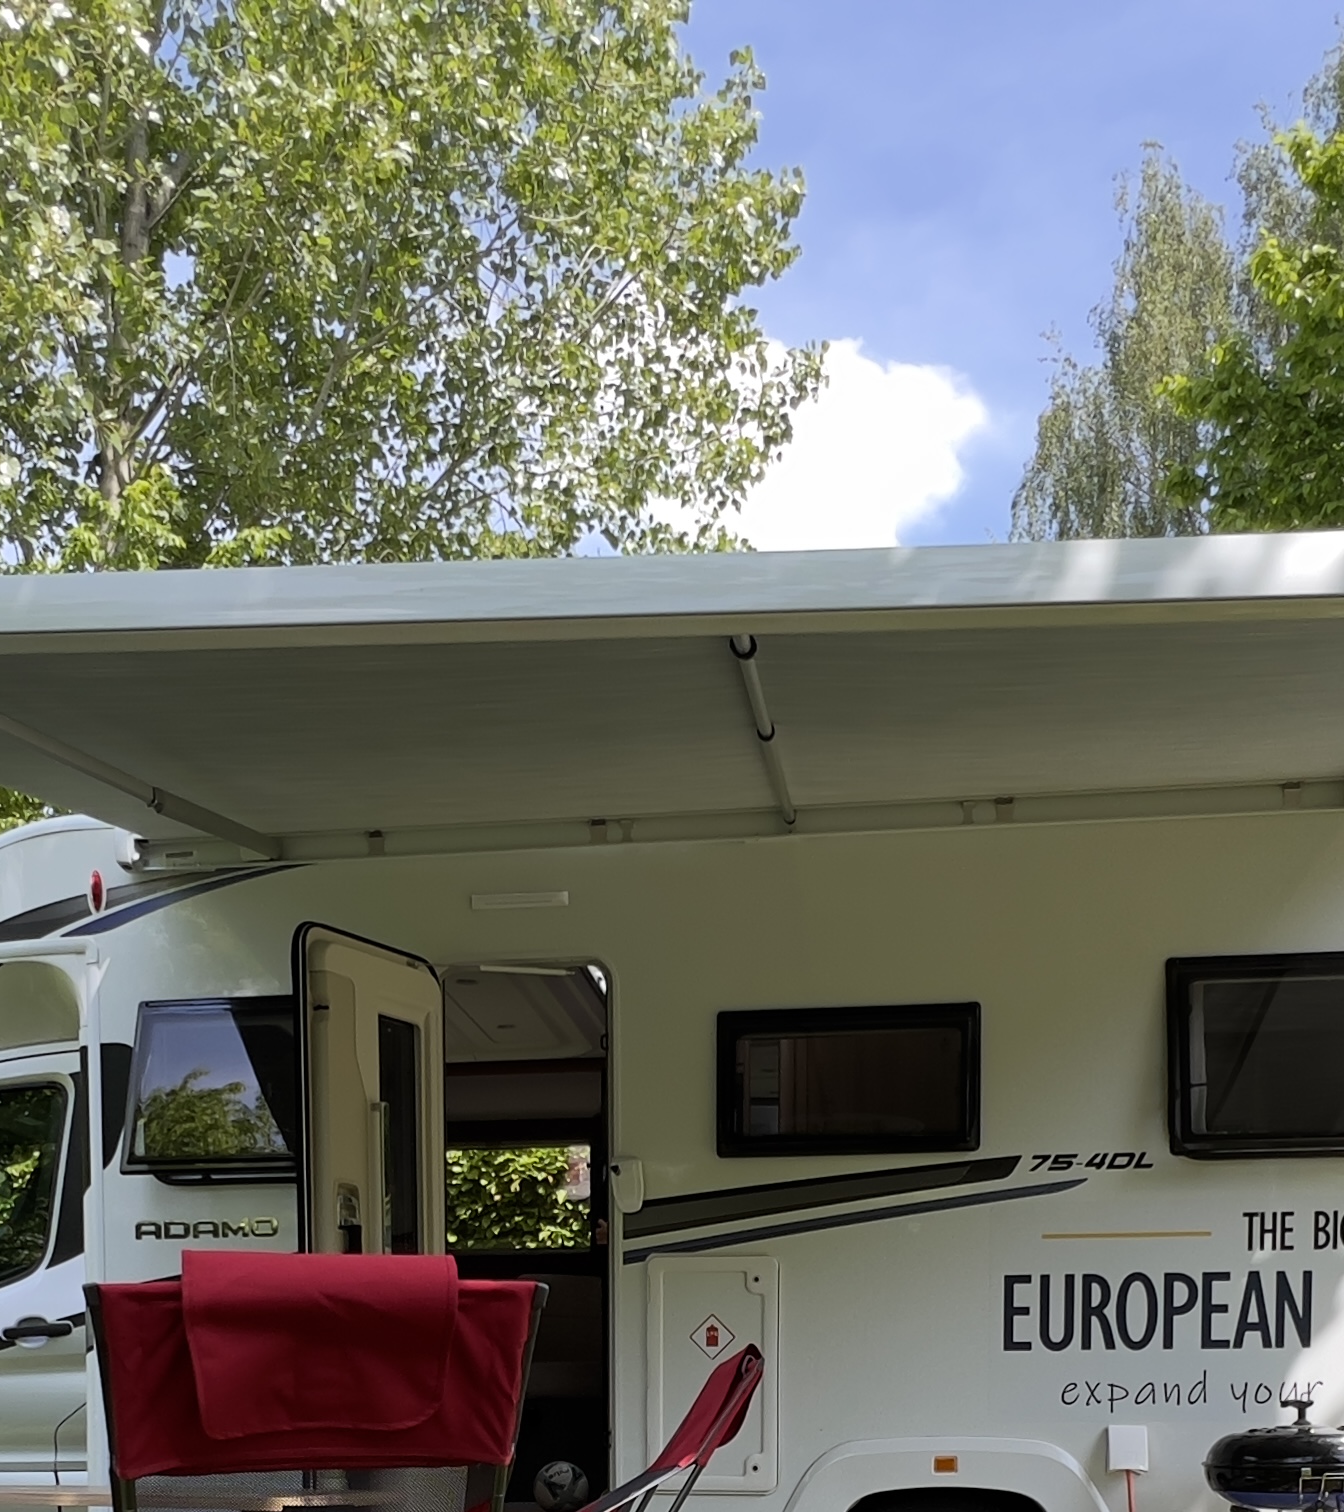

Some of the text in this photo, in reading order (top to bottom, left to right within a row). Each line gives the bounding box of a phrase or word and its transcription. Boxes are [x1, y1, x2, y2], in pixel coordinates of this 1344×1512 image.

[1028, 1152, 1154, 1172] 75-4DL
[135, 1216, 279, 1240] ADAMO
[1242, 1211, 1294, 1251] THE
[1002, 1270, 1313, 1351] EUROPEAN
[1060, 1369, 1208, 1414] expand
[1229, 1379, 1324, 1414] your
